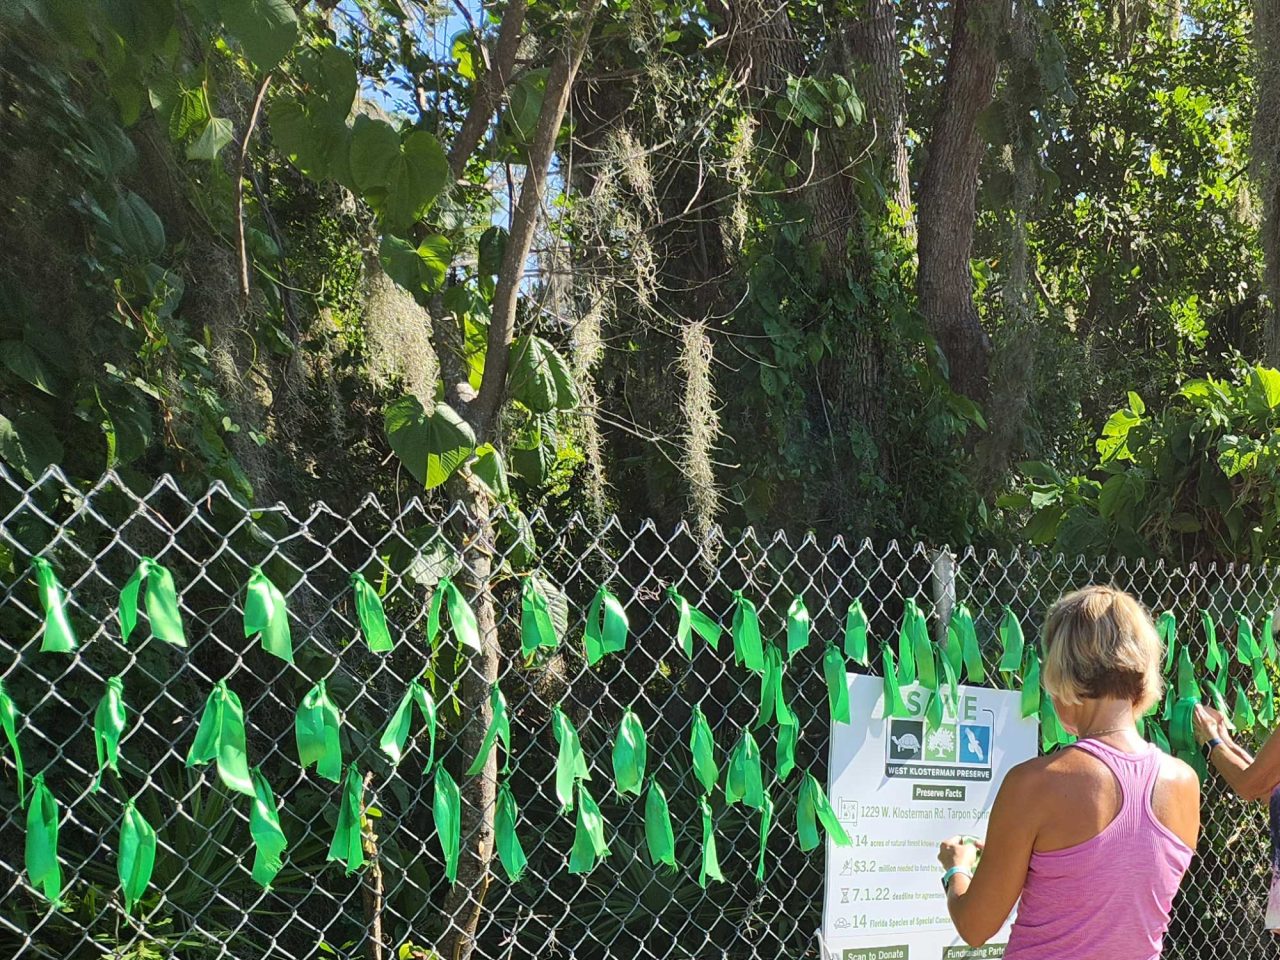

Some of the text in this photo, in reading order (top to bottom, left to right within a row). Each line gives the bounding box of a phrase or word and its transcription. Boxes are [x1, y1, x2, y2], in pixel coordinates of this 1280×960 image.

[907, 691, 977, 720] SVE
[888, 767, 990, 778] WEST KLOSTERMAN PRESERVE
[916, 788, 962, 798] Preserve Facts
[861, 806, 880, 818] 1229
[882, 806, 890, 818] W.
[892, 807, 932, 819] Klosterman
[934, 808, 944, 819] Rd.
[948, 808, 970, 820] Tarpon
[856, 834, 868, 847] 14
[854, 860, 876, 874] $3.2
[852, 888, 890, 900] 7.1.22
[853, 914, 866, 928] 14
[868, 952, 876, 960] to
[878, 950, 904, 960] Donate
